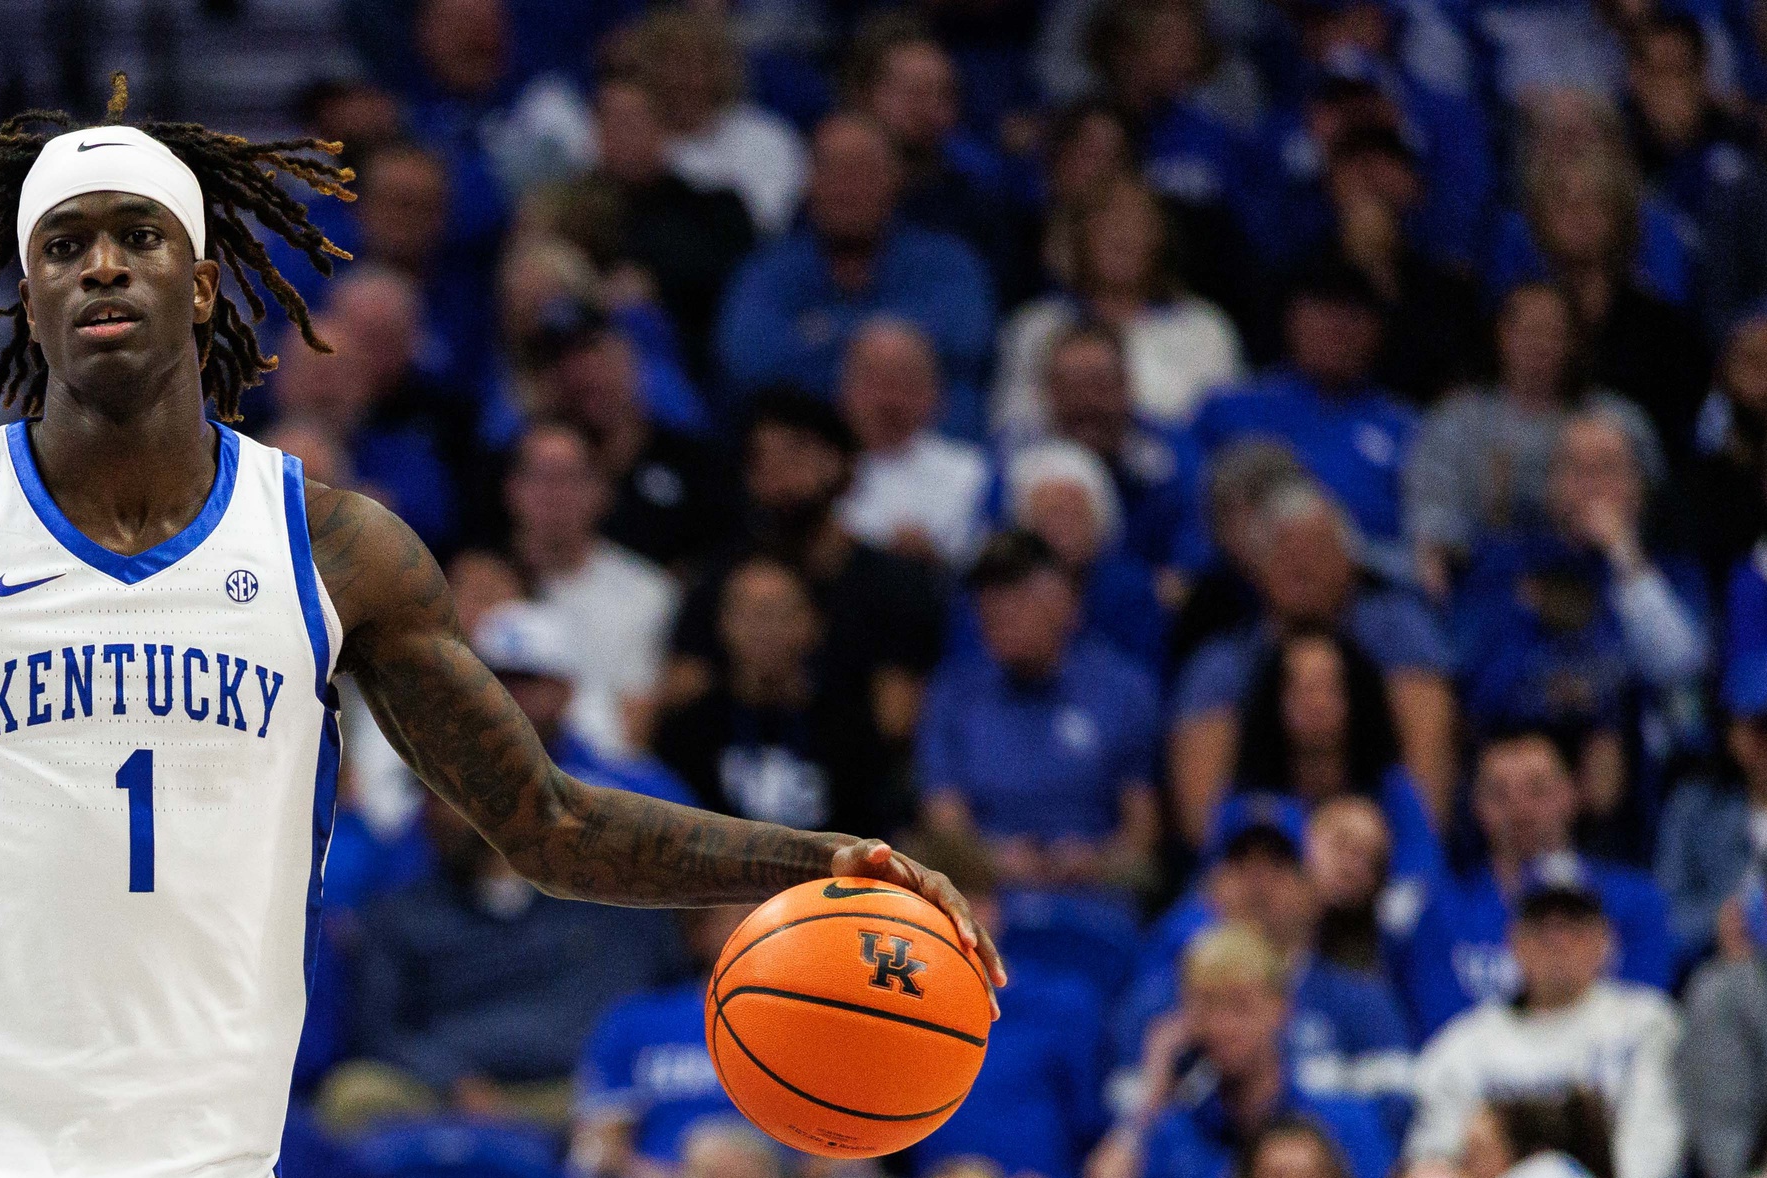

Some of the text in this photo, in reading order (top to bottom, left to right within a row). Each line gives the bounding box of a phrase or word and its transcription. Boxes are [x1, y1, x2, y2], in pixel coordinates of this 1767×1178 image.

[227, 571, 258, 601] SEC
[115, 748, 155, 893] 1
[858, 930, 929, 1000] UK
